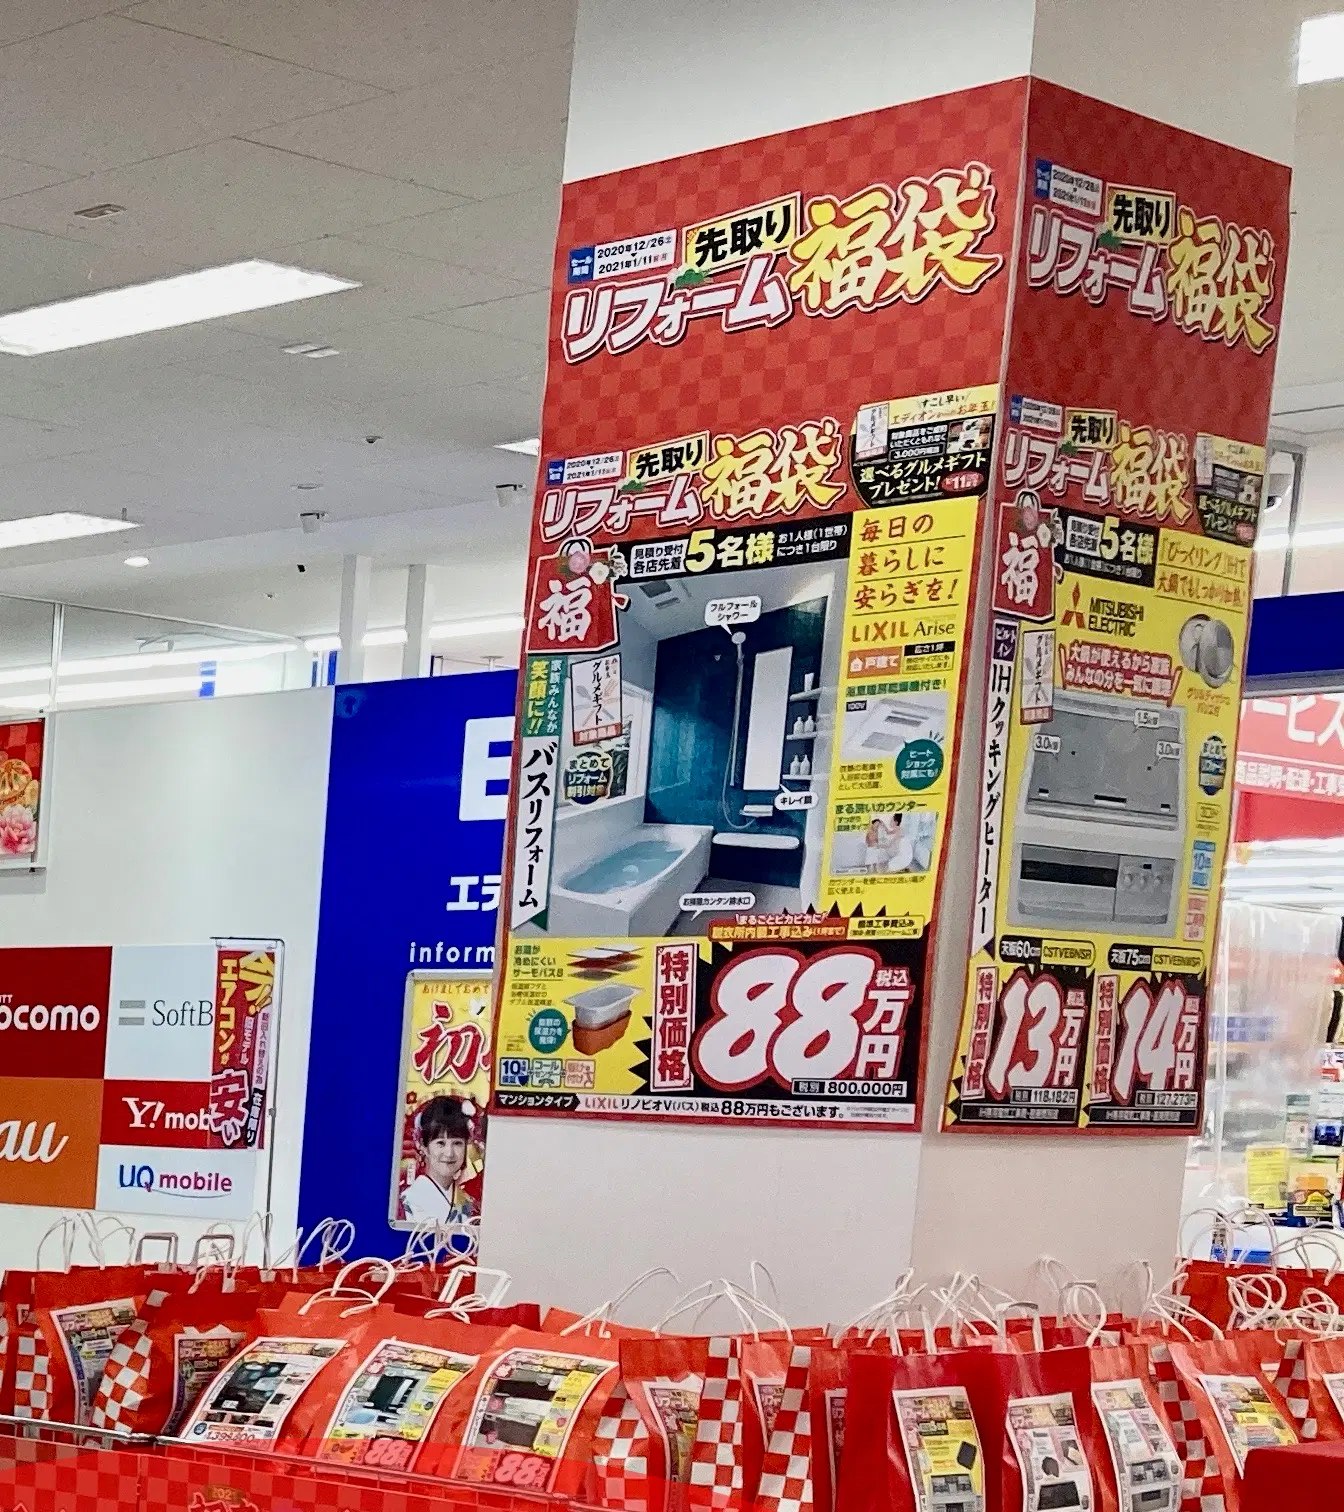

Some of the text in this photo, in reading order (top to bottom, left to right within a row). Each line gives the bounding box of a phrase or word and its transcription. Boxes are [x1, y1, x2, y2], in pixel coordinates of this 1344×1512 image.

[695, 207, 793, 266] 先取り
[791, 163, 1000, 314] 福袋
[1113, 194, 1171, 237] 先取り
[1030, 208, 1166, 320] リフォーム
[1169, 206, 1275, 352] 福袋
[564, 255, 792, 361] リフォーム
[1070, 416, 1115, 445] 先取り
[635, 438, 705, 481] 先取り
[702, 418, 846, 518] 福袋
[860, 452, 986, 484] 選べるグルメギフト
[1004, 428, 1110, 508] リフォーム
[1111, 420, 1194, 526] 福袋
[543, 473, 704, 541] リフォーム
[859, 513, 934, 543] 毎日の
[684, 529, 776, 574] 5名様
[858, 545, 945, 577] 暮らしに
[1099, 516, 1155, 566] 5名様
[633, 556, 681, 574] 各店先着
[1001, 532, 1041, 607] 福
[538, 578, 594, 643] 福
[851, 619, 956, 643] LIXIL Arise
[1088, 613, 1136, 638] ELECTRIC
[1089, 596, 1146, 622] MITSUBISHI
[569, 758, 610, 769] まとめて
[522, 741, 558, 908] バスリフォーム
[152, 999, 213, 1028] SoftB
[657, 950, 690, 1083] 特別価格
[698, 951, 877, 1085] 88
[987, 976, 1061, 1094] 13
[412, 1002, 491, 1085] 初
[1114, 985, 1184, 1100] 14
[499, 1093, 574, 1107] マンションタイプ
[584, 1096, 619, 1110] LIXIL
[118, 1164, 233, 1194] UQ mobile
[365, 1438, 408, 1466] 88
[494, 1453, 544, 1486] 88
